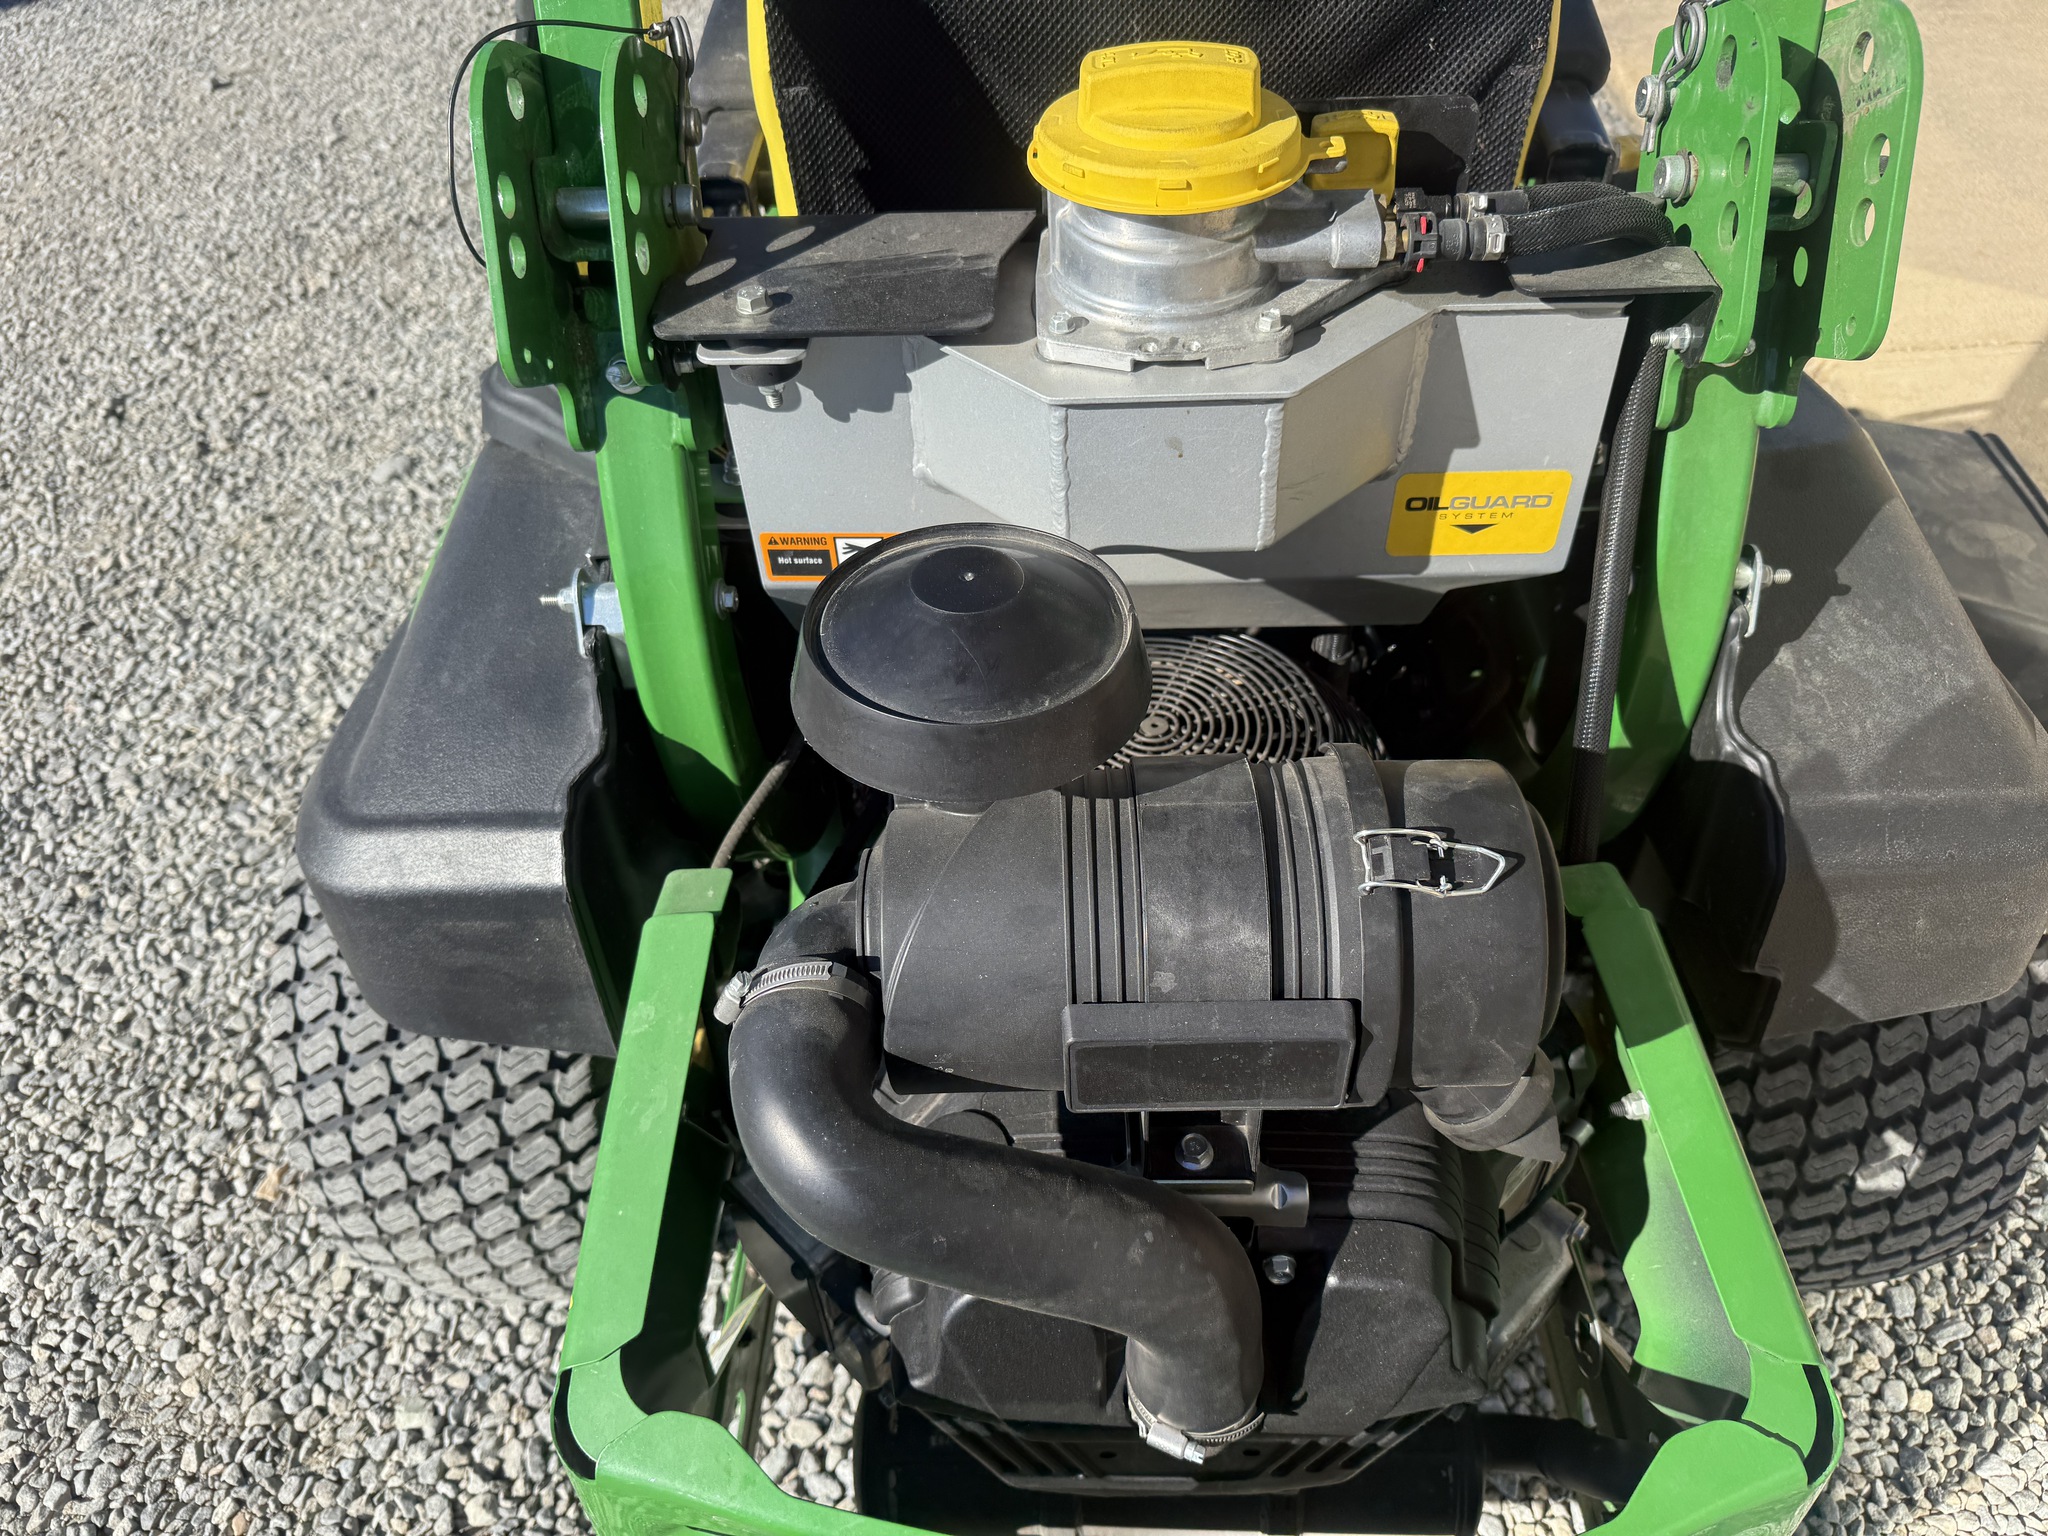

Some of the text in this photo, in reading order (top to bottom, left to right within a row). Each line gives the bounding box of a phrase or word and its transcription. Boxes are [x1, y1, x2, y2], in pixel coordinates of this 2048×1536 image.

[1405, 495, 1553, 511] OILGUARD
[1439, 512, 1514, 520] SYSTEM
[779, 536, 828, 546] WARNING
[778, 556, 823, 564] Hot surface
